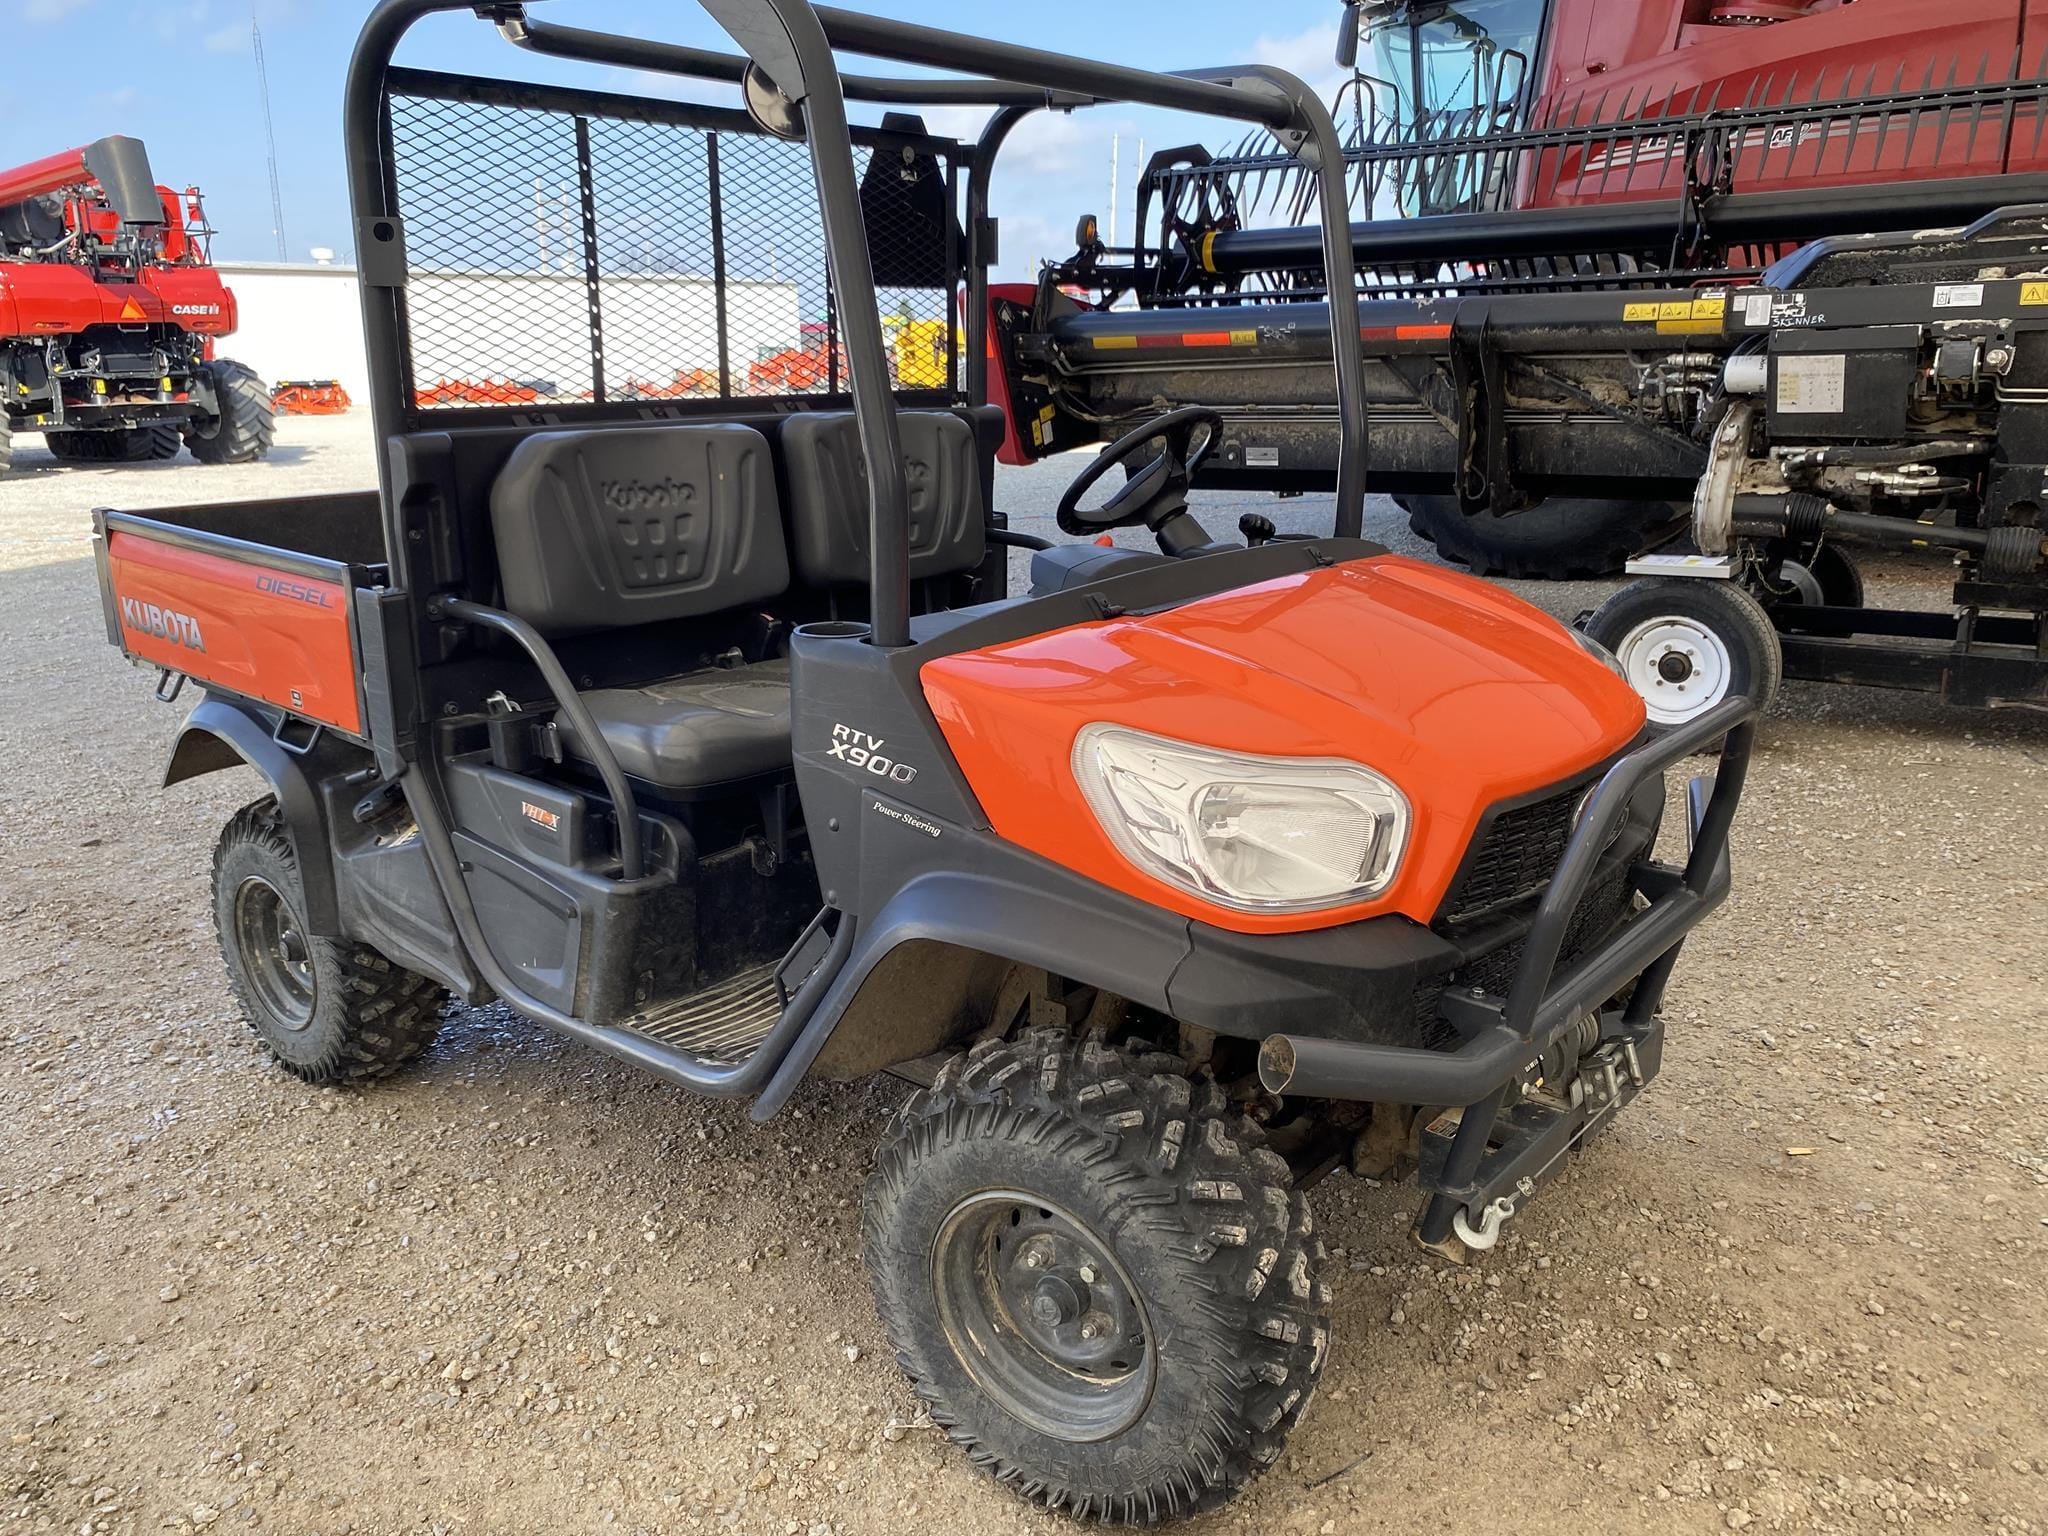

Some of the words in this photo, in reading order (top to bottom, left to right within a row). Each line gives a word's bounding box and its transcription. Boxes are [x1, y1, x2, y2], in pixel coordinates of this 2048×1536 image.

[172, 304, 208, 315] CASE
[1771, 313, 1827, 328] SKINNER
[255, 574, 334, 609] DIESEL
[121, 594, 207, 653] KUBOTA
[832, 723, 885, 751] RTV
[825, 738, 918, 785] X900
[873, 801, 903, 820] Power
[901, 813, 942, 837] Steering
